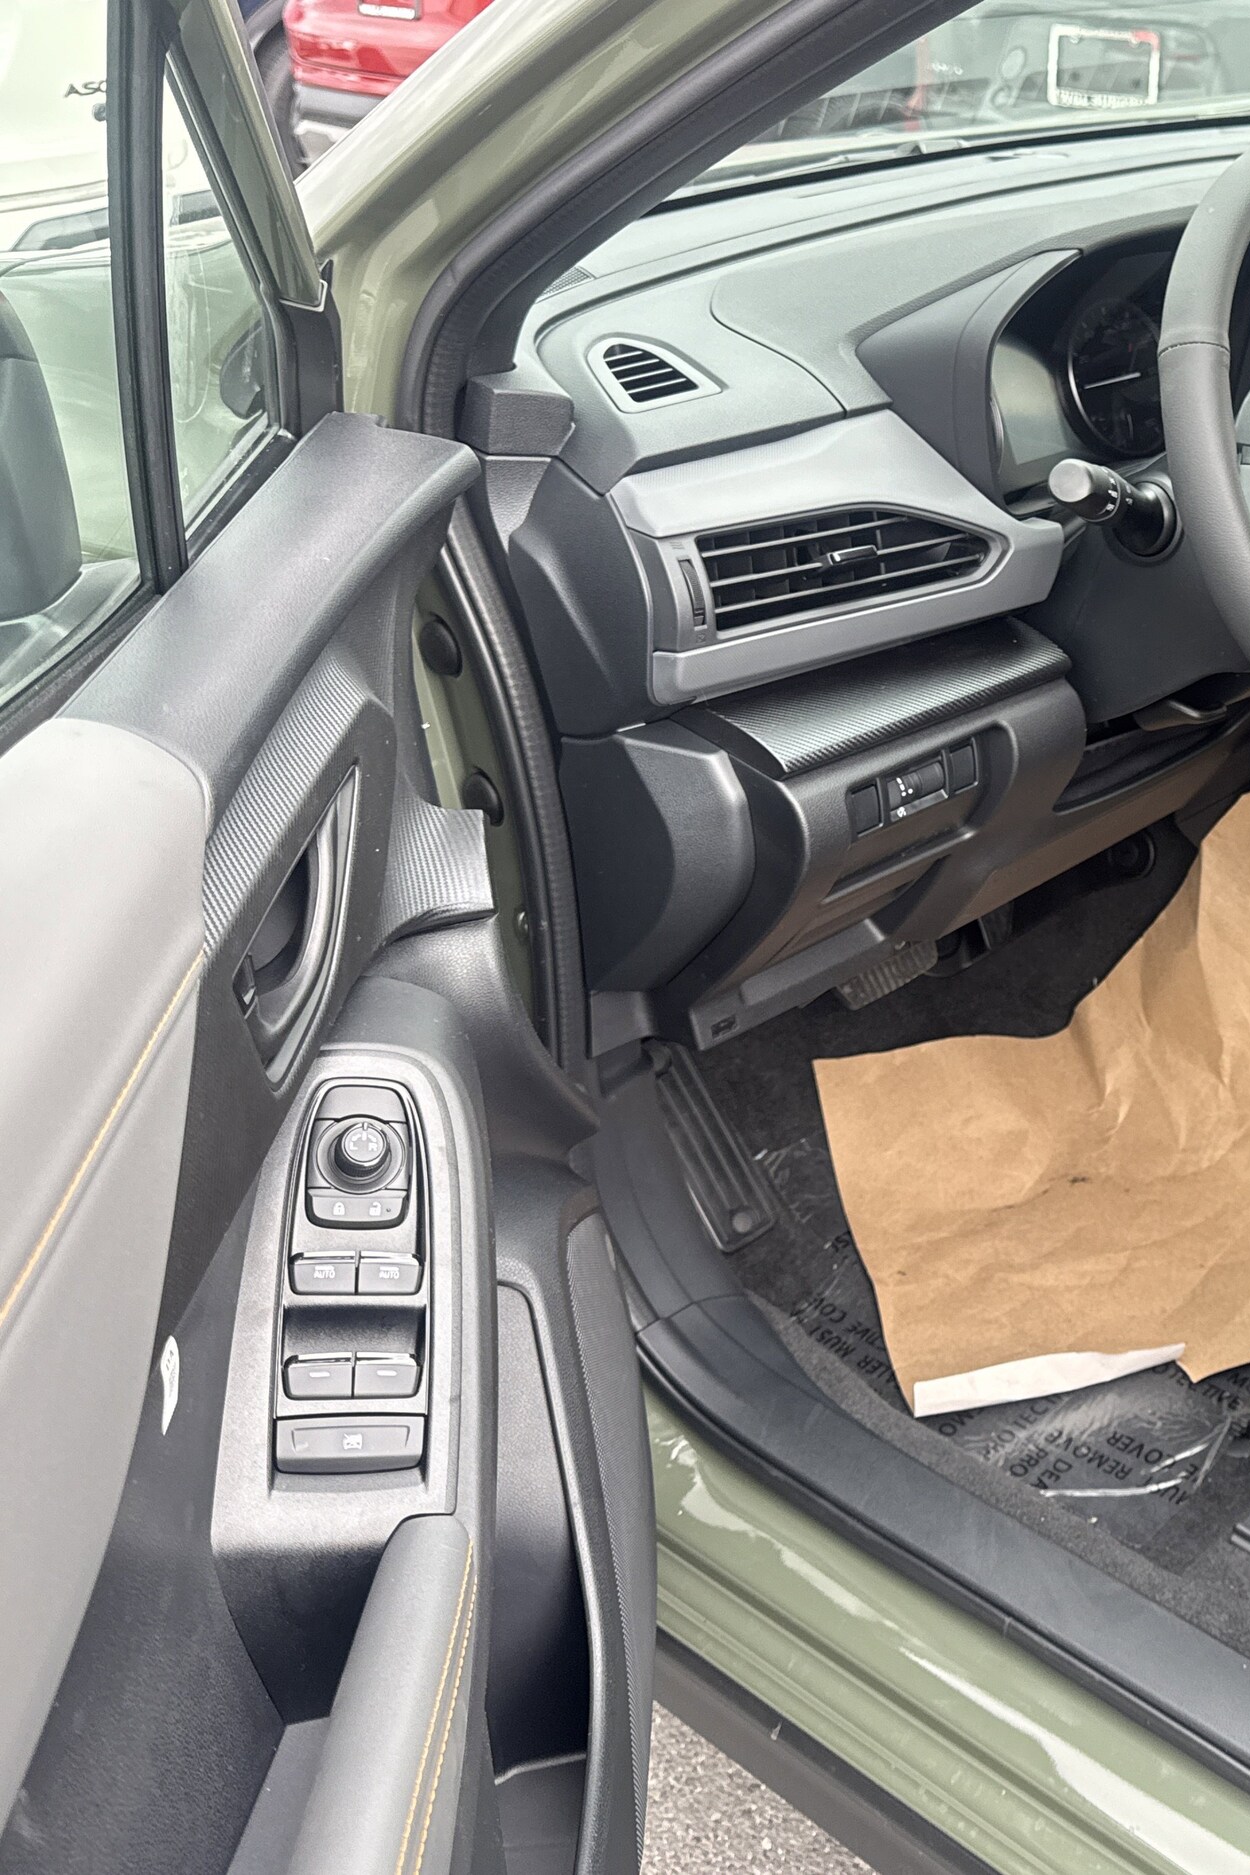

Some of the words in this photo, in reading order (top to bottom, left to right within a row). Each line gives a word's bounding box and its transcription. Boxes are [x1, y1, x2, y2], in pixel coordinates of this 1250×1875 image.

[350, 1141, 358, 1150] L
[368, 1142, 378, 1151] R
[313, 1270, 336, 1279] AUTO
[378, 1270, 401, 1280] AUTO
[808, 1326, 856, 1360] MUST
[1044, 1430, 1134, 1481] REMOVE
